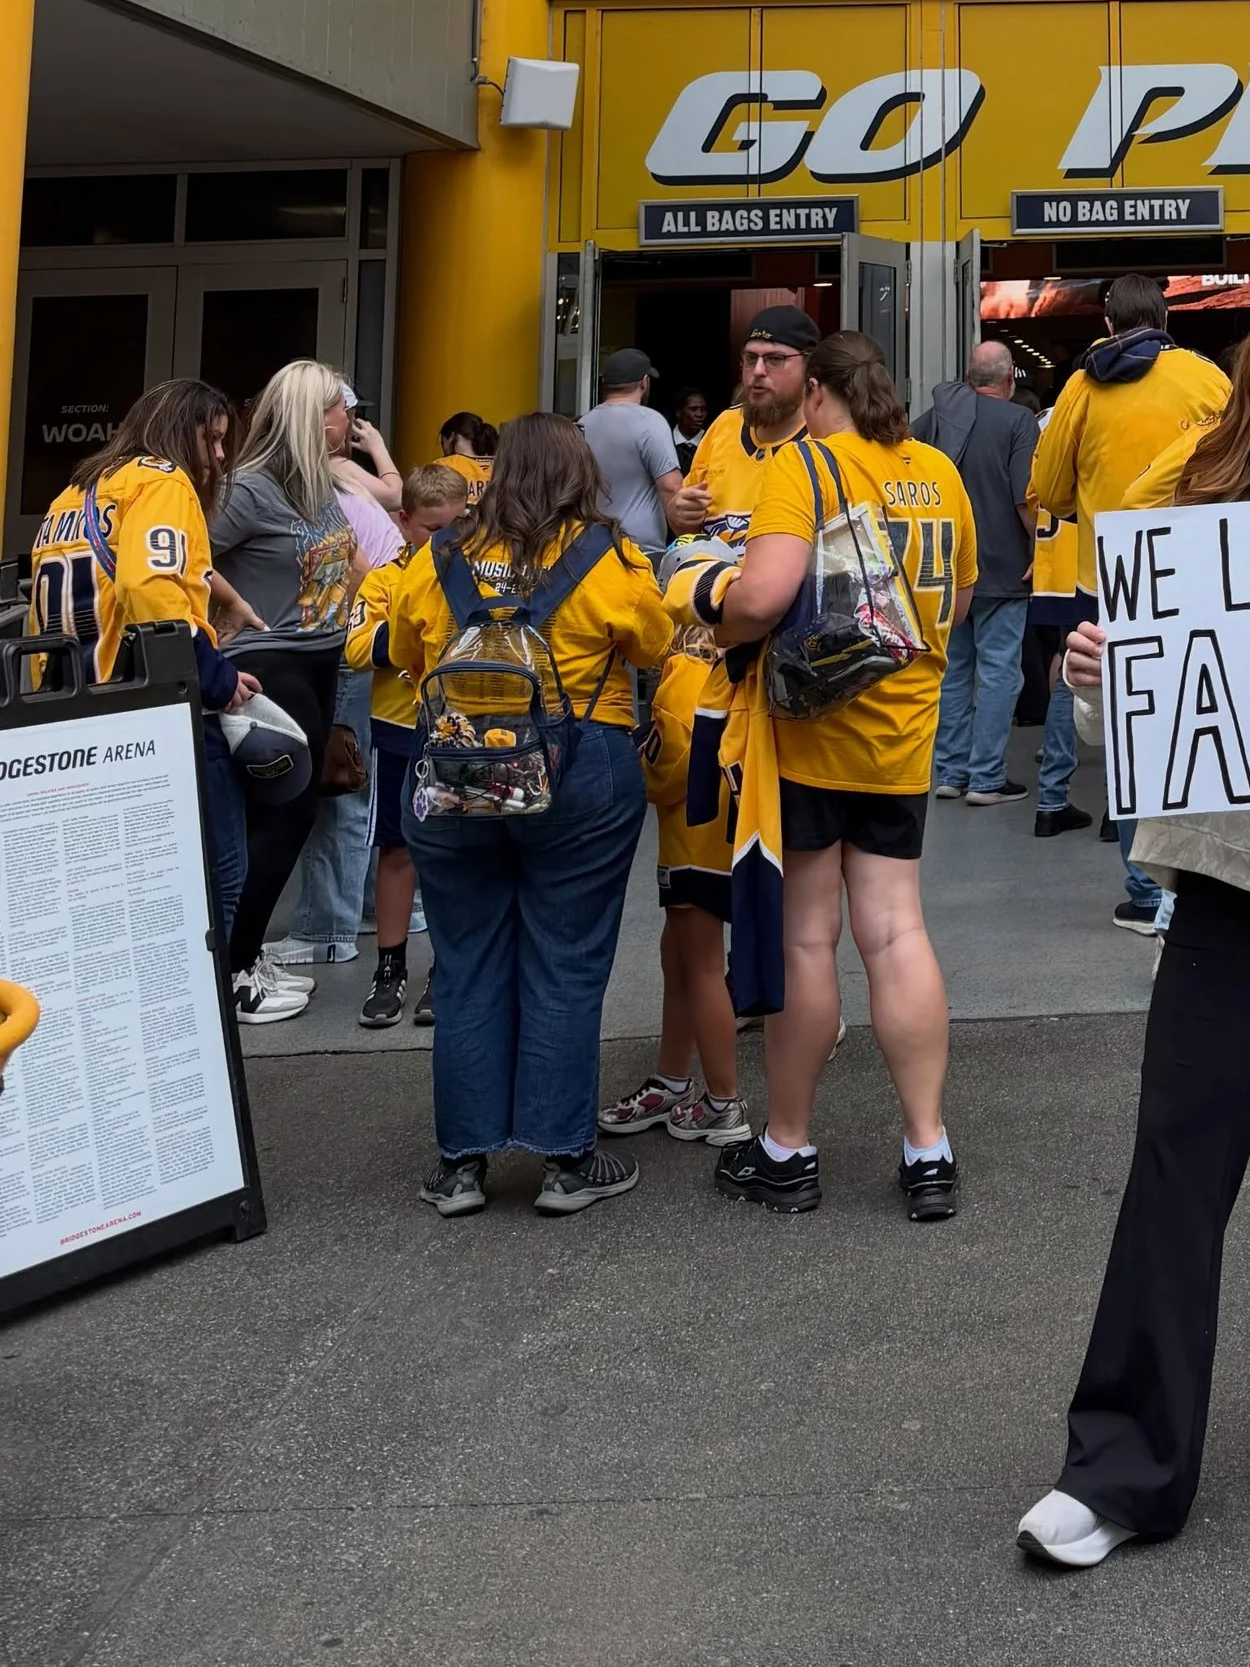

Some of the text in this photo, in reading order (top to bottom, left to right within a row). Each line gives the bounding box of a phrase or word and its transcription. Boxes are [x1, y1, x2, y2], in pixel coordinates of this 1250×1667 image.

[645, 69, 986, 185] GO
[662, 207, 838, 233] ALL BAGS ENTRY
[1043, 198, 1191, 223] NO BAG ENTRY
[884, 480, 942, 507] SAROS
[1097, 526, 1180, 622] WE
[103, 739, 156, 764] ARENA
